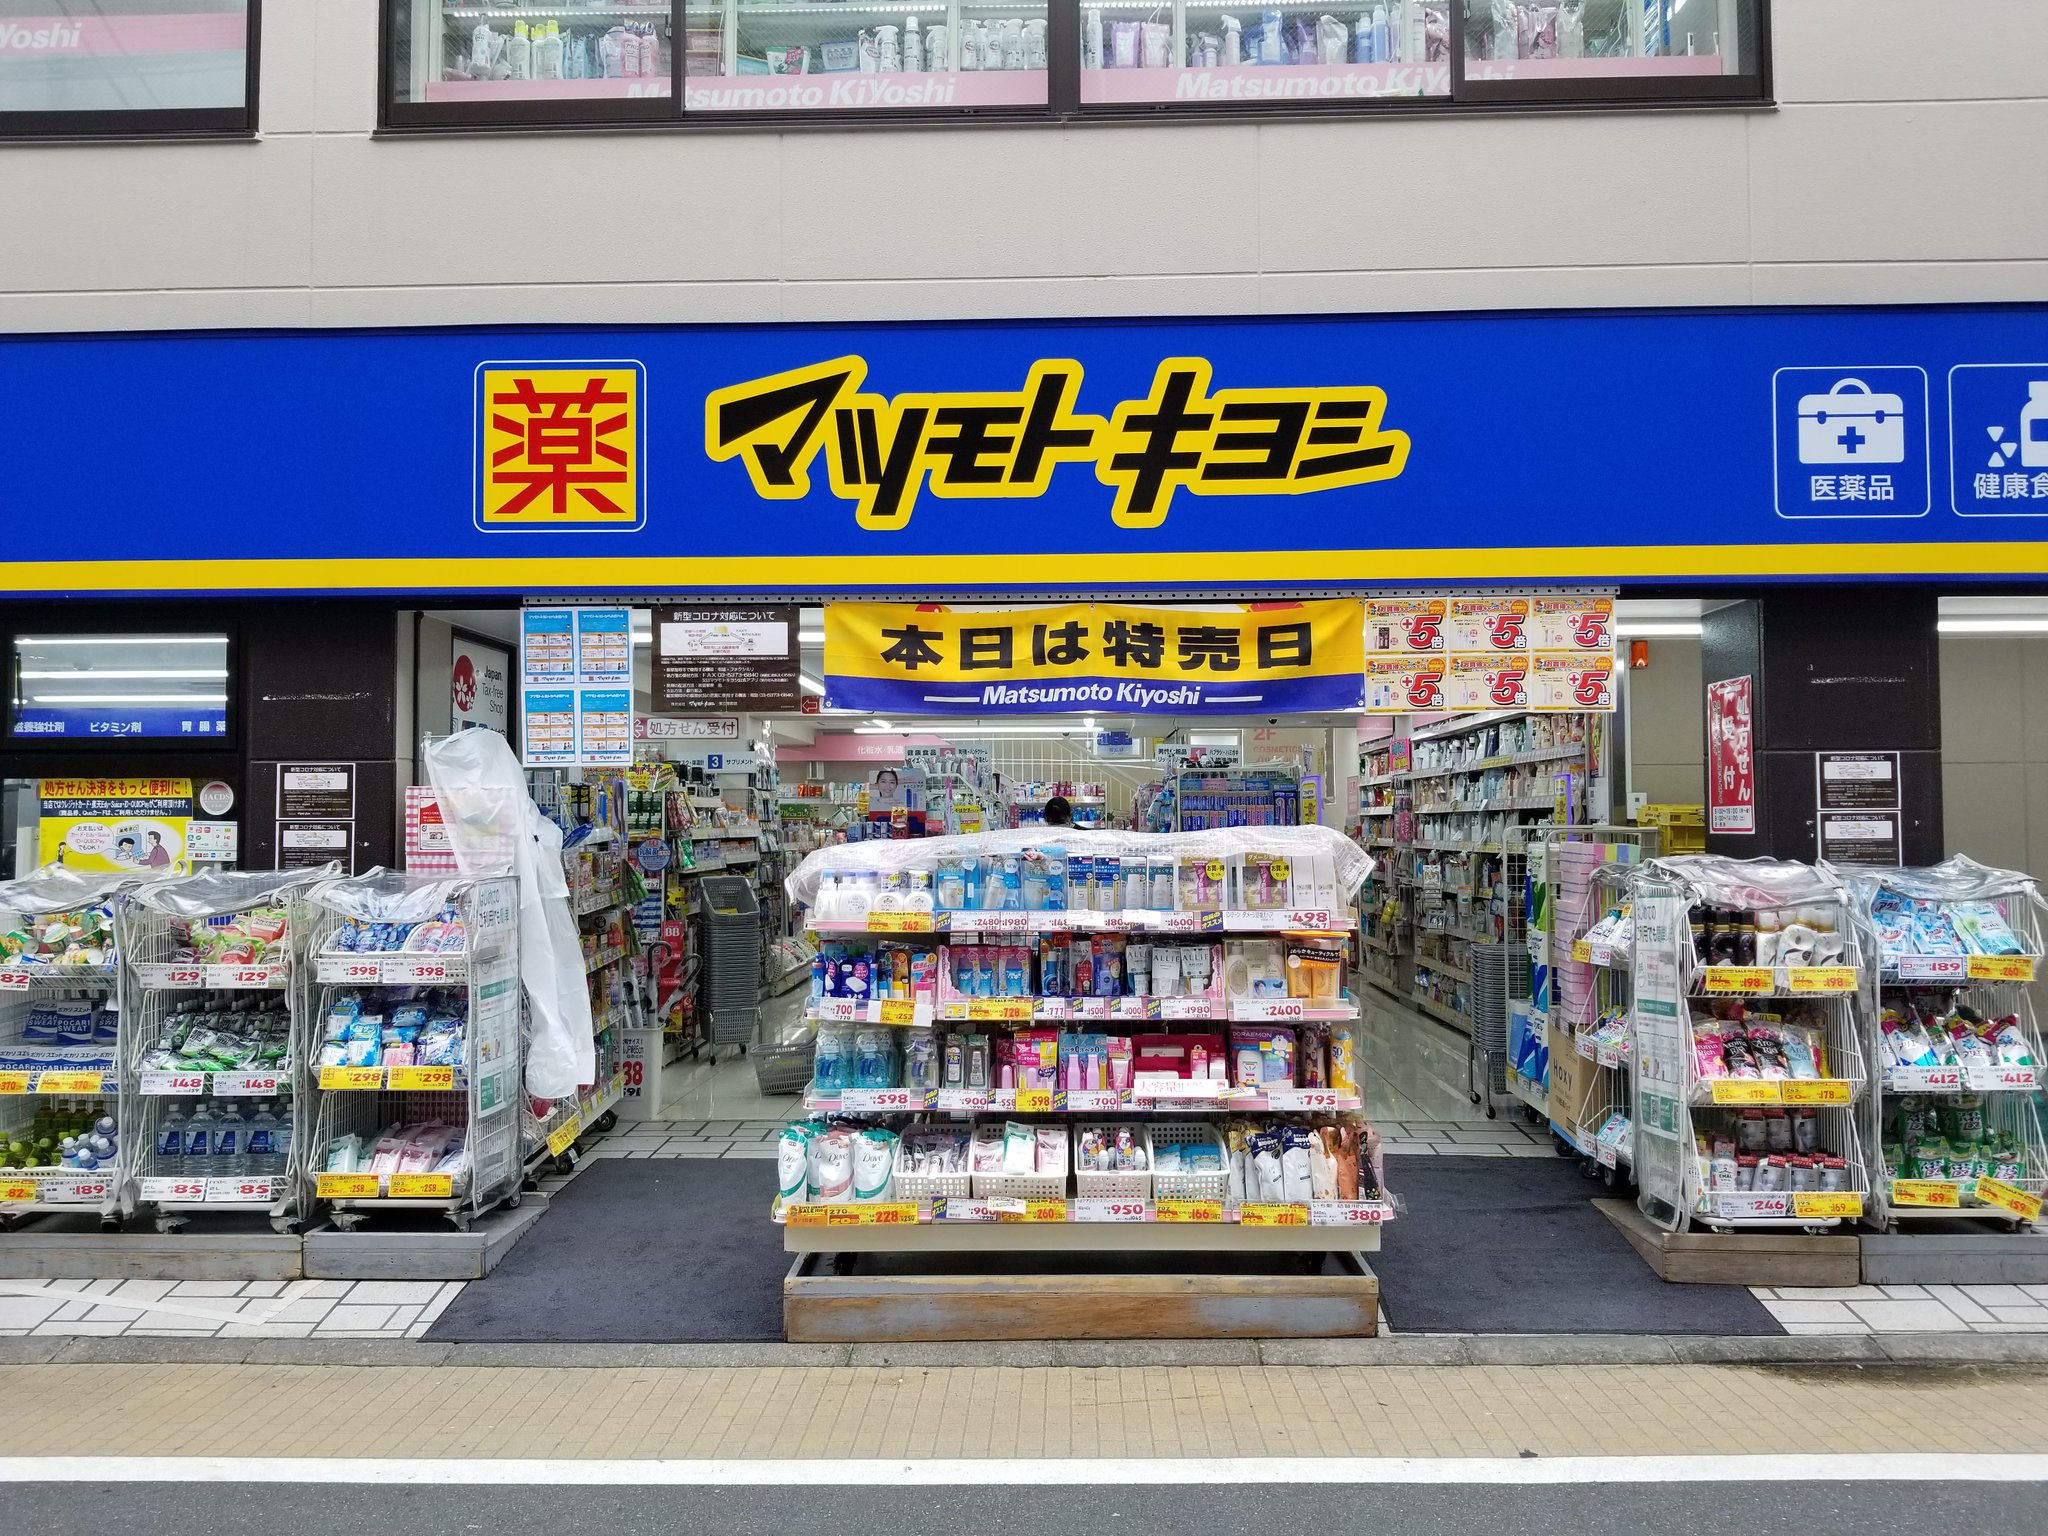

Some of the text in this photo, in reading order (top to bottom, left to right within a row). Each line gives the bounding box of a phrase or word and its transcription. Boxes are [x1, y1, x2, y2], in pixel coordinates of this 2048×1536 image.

[1175, 68, 1378, 98] Matsumoto
[628, 77, 956, 108] Msumoto KiYoshi
[493, 378, 628, 514] 薬
[712, 364, 1404, 522] マツモトキヨシ
[1811, 475, 1895, 500] 医薬品
[1973, 472, 2048, 499] 健康食
[673, 611, 776, 621] 新型コロナ対応について
[881, 620, 1313, 671] 本日は特売日
[481, 683, 504, 699] Tax-free
[982, 682, 1201, 707] Matsumoto Kiyoshi
[489, 700, 504, 716] Shop
[90, 721, 142, 733] ビタミン剤
[650, 721, 736, 736] 処方せん受付
[1736, 695, 1751, 802] 処方せん
[711, 756, 720, 768] 3
[44, 780, 189, 797] 処方せん決済をもっと便利に！
[977, 918, 1000, 926] 2480
[1003, 918, 1027, 926] 1980
[1170, 918, 1193, 926] 1600
[1292, 912, 1328, 922] 498
[902, 921, 919, 931] 242
[665, 927, 680, 937] BB
[1153, 954, 1180, 962] ALLIE
[1182, 953, 1209, 961] ALLIE
[349, 966, 378, 976] 398
[415, 966, 445, 976] 398
[1931, 963, 1961, 971] 189
[2002, 967, 2019, 977] 260
[170, 971, 200, 982] 129
[237, 971, 268, 982] 129
[1743, 977, 1761, 987] 198
[1825, 977, 1844, 987] 198
[835, 1004, 853, 1015] 700
[1003, 1008, 1020, 1017] 728
[1049, 1007, 1064, 1015] 777
[1088, 1007, 1104, 1015] 1500
[1126, 1007, 1142, 1015] 1000
[1186, 1005, 1210, 1014] 1980
[1269, 1005, 1302, 1016] 2400
[1232, 1030, 1272, 1038] DORAEMON
[0, 1063, 30, 1071] POCAR
[352, 1072, 381, 1082] 298
[422, 1073, 452, 1083] 298
[1552, 1057, 1573, 1092] HOXY
[1928, 1073, 1959, 1084] 412
[2004, 1073, 2034, 1083] 412
[172, 1078, 203, 1088] 148
[245, 1079, 276, 1089] 148
[1751, 1090, 1765, 1098] 178
[1820, 1090, 1835, 1099] 178
[877, 1094, 909, 1105] 598
[964, 1097, 987, 1105] 900
[1031, 1095, 1050, 1106] 598
[1094, 1097, 1117, 1105] 700
[1304, 1094, 1336, 1105] 795
[828, 1152, 849, 1162] Dove
[862, 1152, 884, 1162] Dove
[8, 1188, 24, 1198] 82
[74, 1184, 105, 1195] 189
[174, 1184, 203, 1194] 85
[240, 1184, 270, 1194] 85
[351, 1184, 365, 1193] 258
[423, 1184, 437, 1193] 258
[1928, 1192, 1945, 1202] 159
[1110, 1204, 1144, 1215] 950
[1754, 1200, 1785, 1210] 246
[1831, 1203, 1846, 1212] 169
[875, 1210, 899, 1223] 228
[1037, 1209, 1054, 1218] 260
[1191, 1209, 1210, 1219] 166
[1278, 1213, 1296, 1223] 277
[1348, 1210, 1381, 1221] 380
